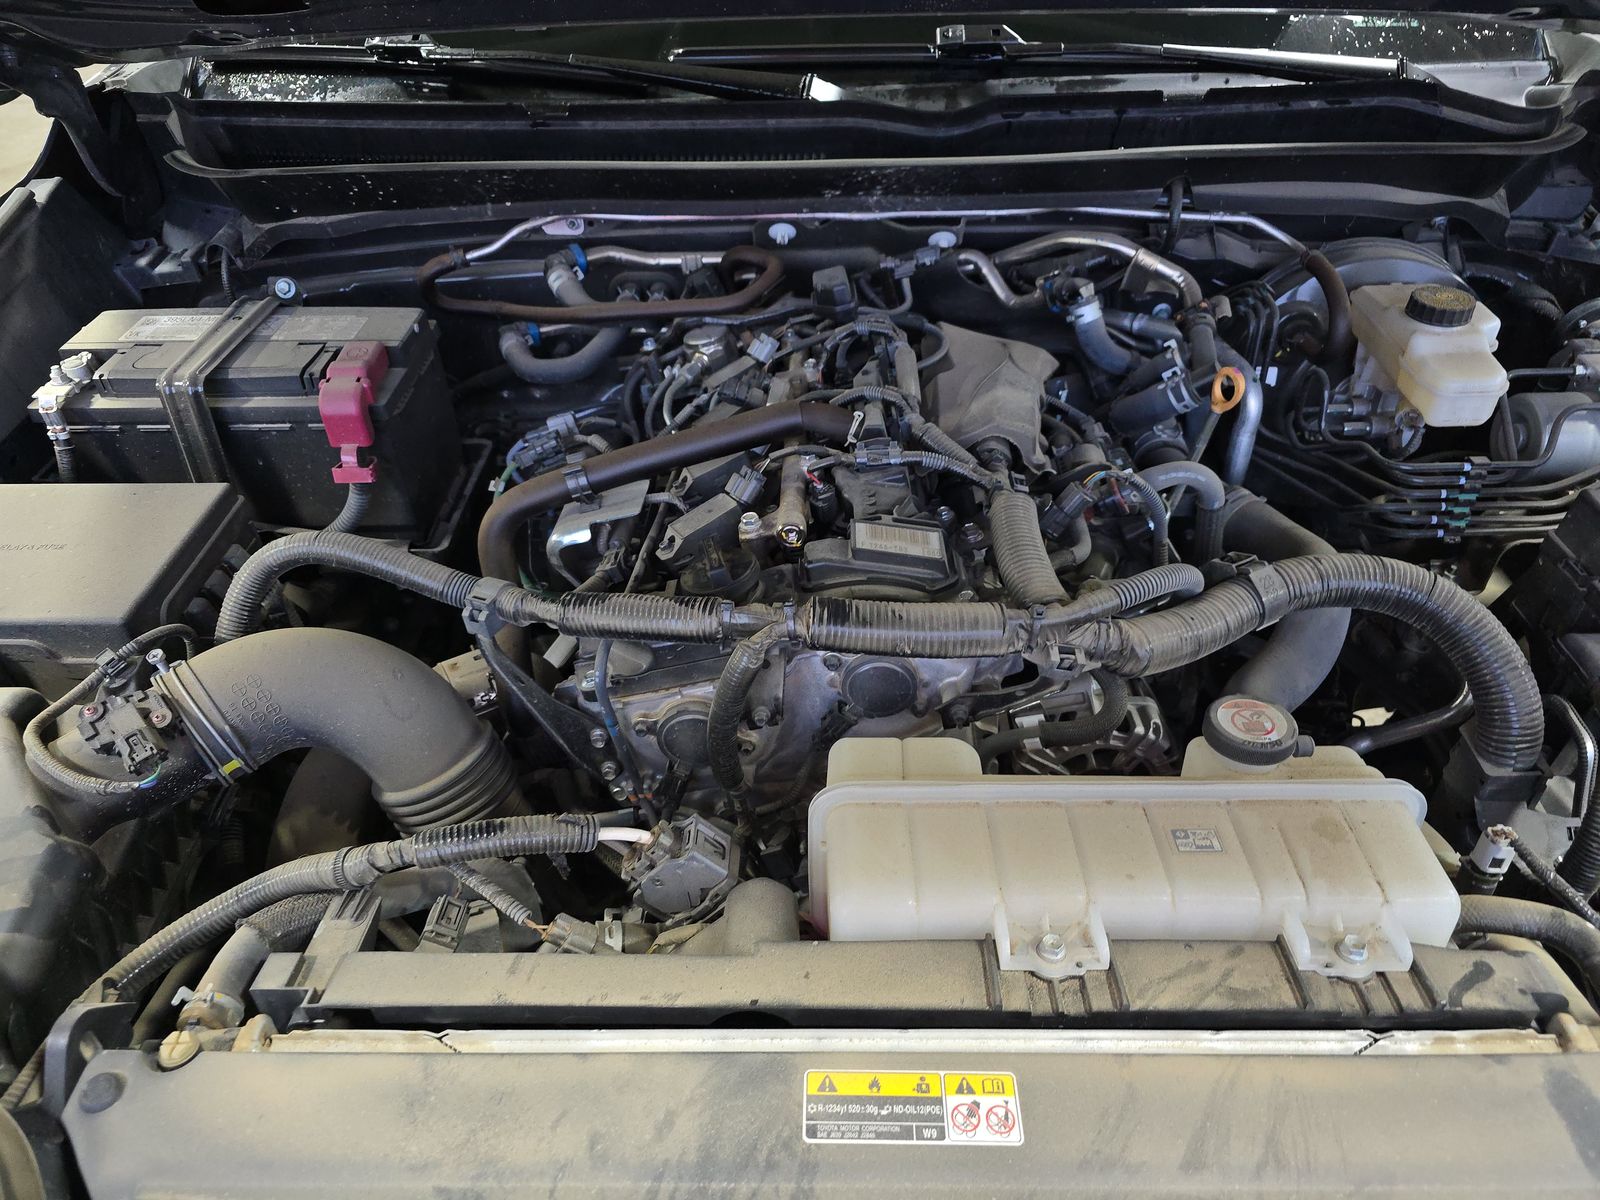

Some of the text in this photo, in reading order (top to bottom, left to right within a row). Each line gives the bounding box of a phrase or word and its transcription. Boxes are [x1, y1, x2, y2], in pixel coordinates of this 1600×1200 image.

[817, 1124, 900, 1133] TOYOTA MOTOR CORPORATION
[922, 1128, 938, 1139] W9
